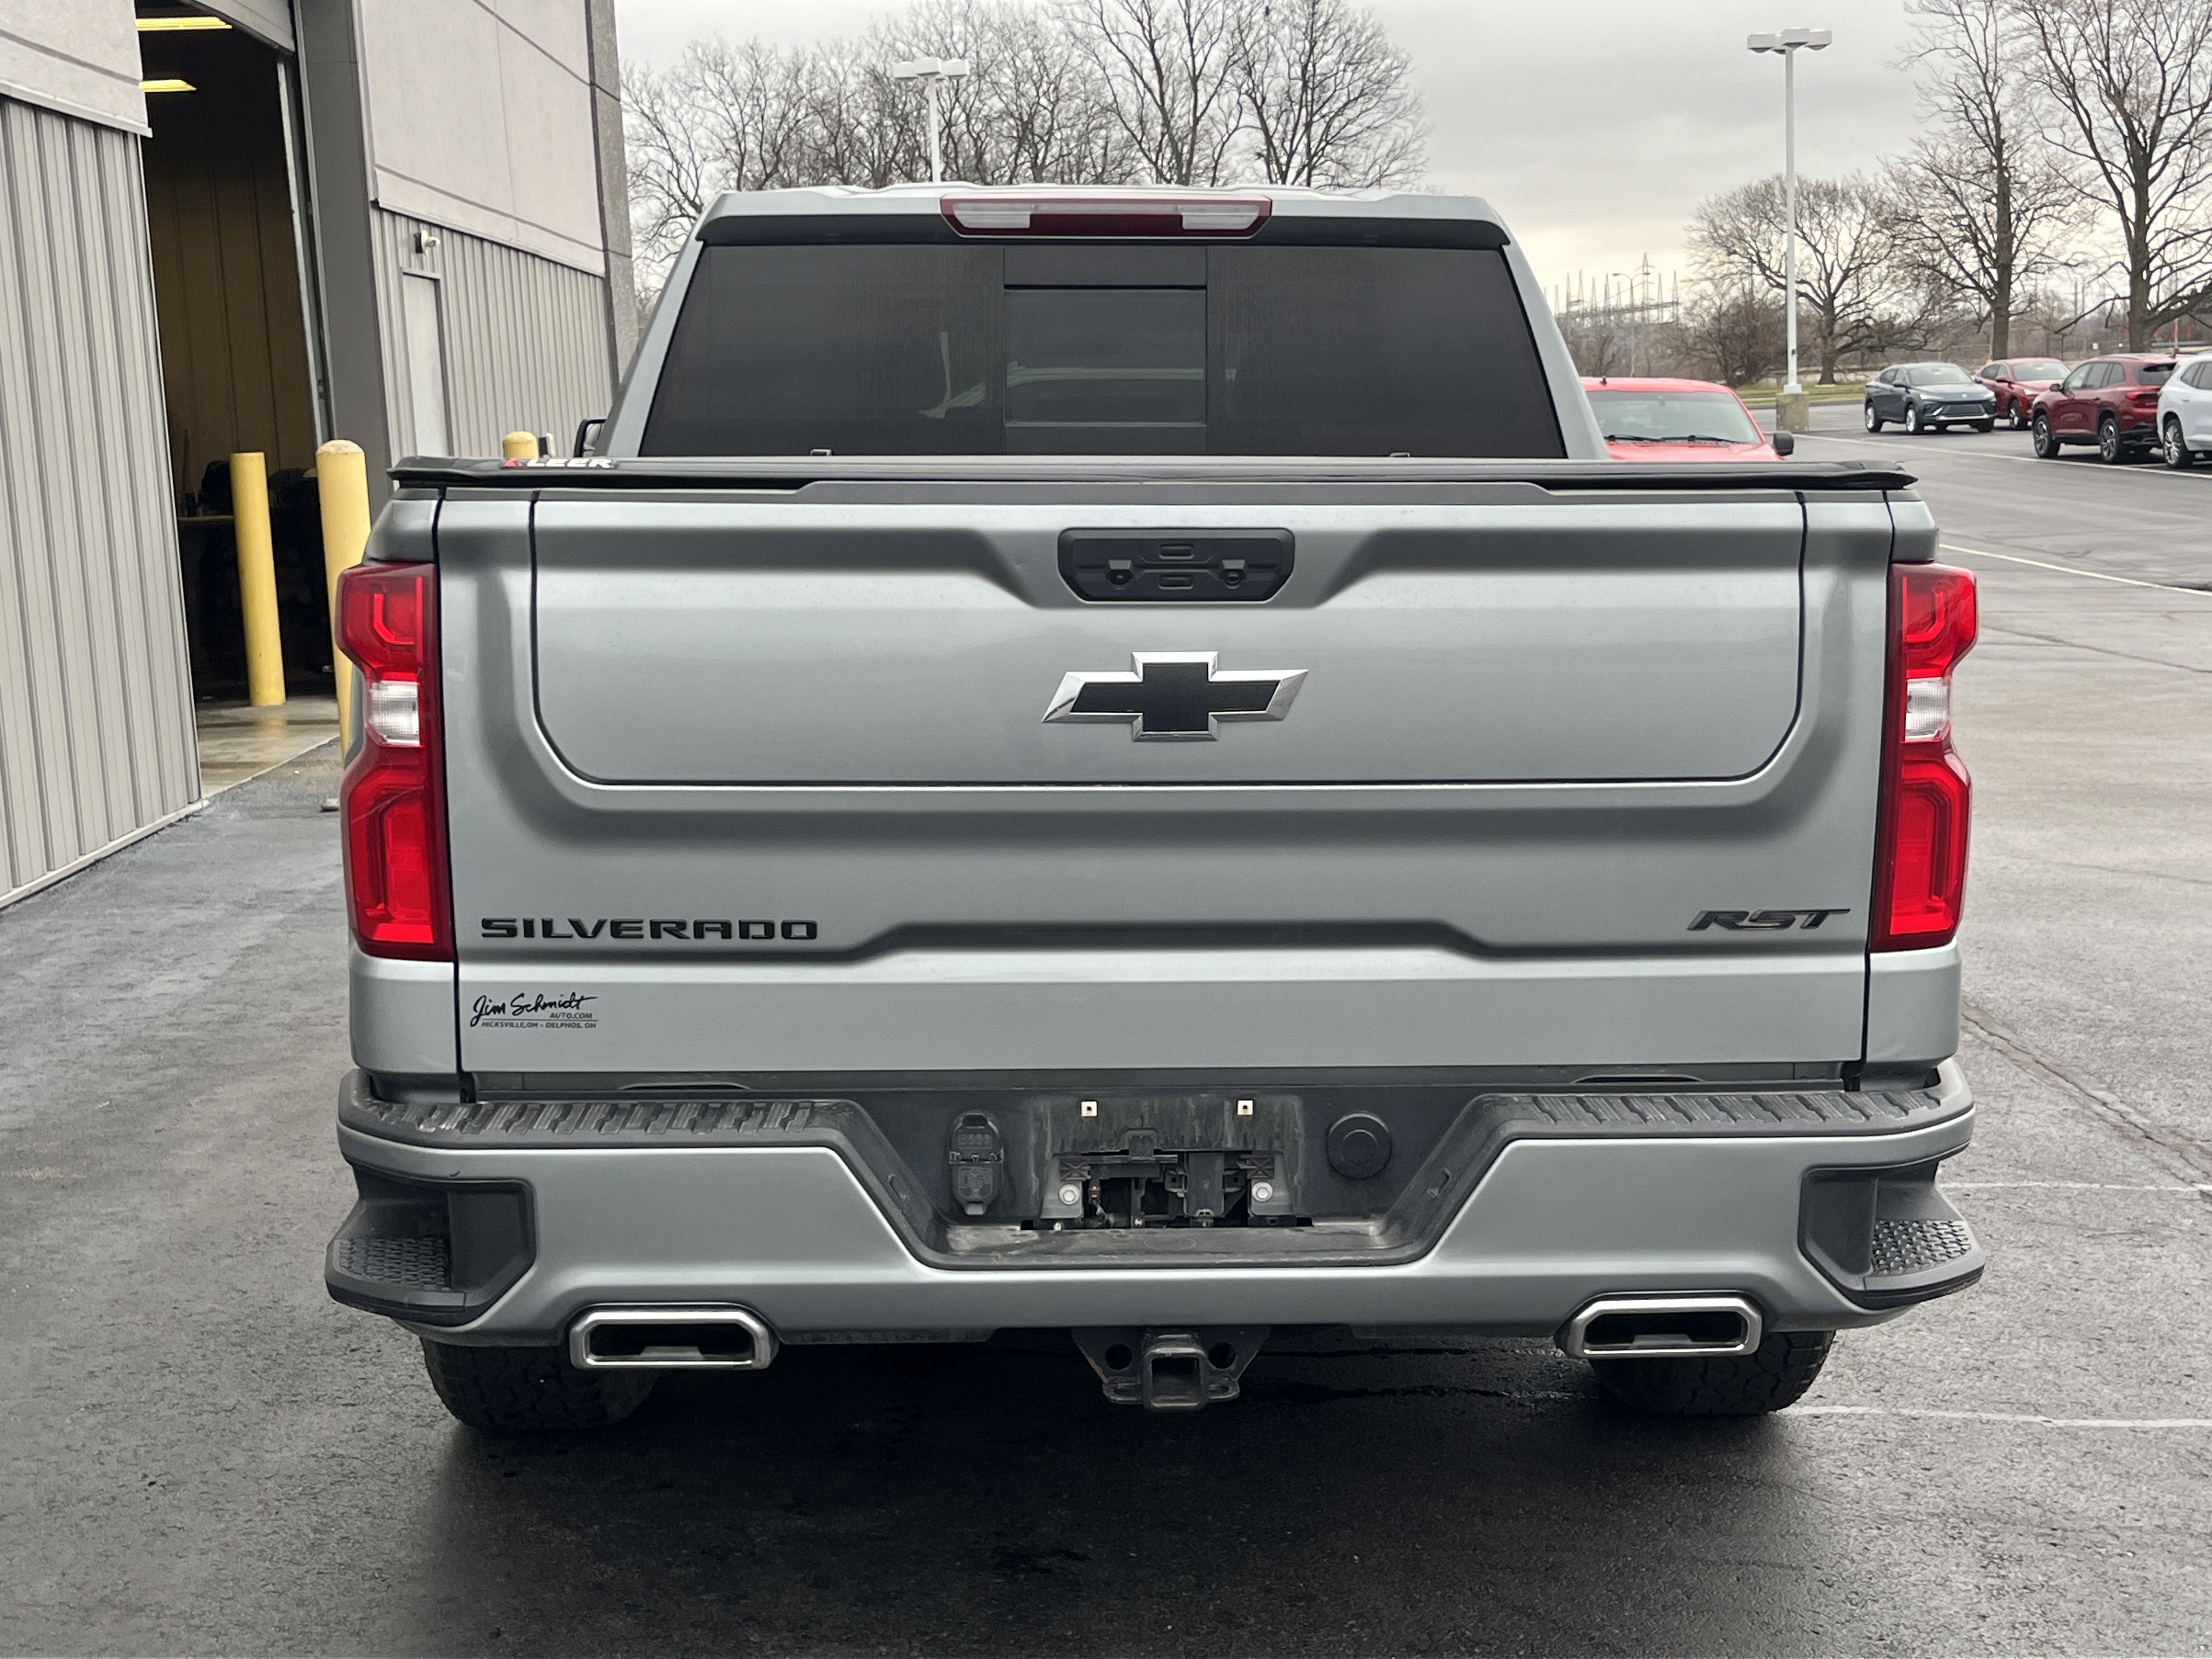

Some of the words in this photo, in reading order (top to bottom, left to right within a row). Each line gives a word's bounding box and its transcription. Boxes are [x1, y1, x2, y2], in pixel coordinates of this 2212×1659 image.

[527, 459, 614, 469] LEER
[481, 918, 817, 940] SILVERADO
[1686, 909, 1851, 930] RST
[470, 995, 506, 1027] Jim
[510, 992, 599, 1016] Schmidt
